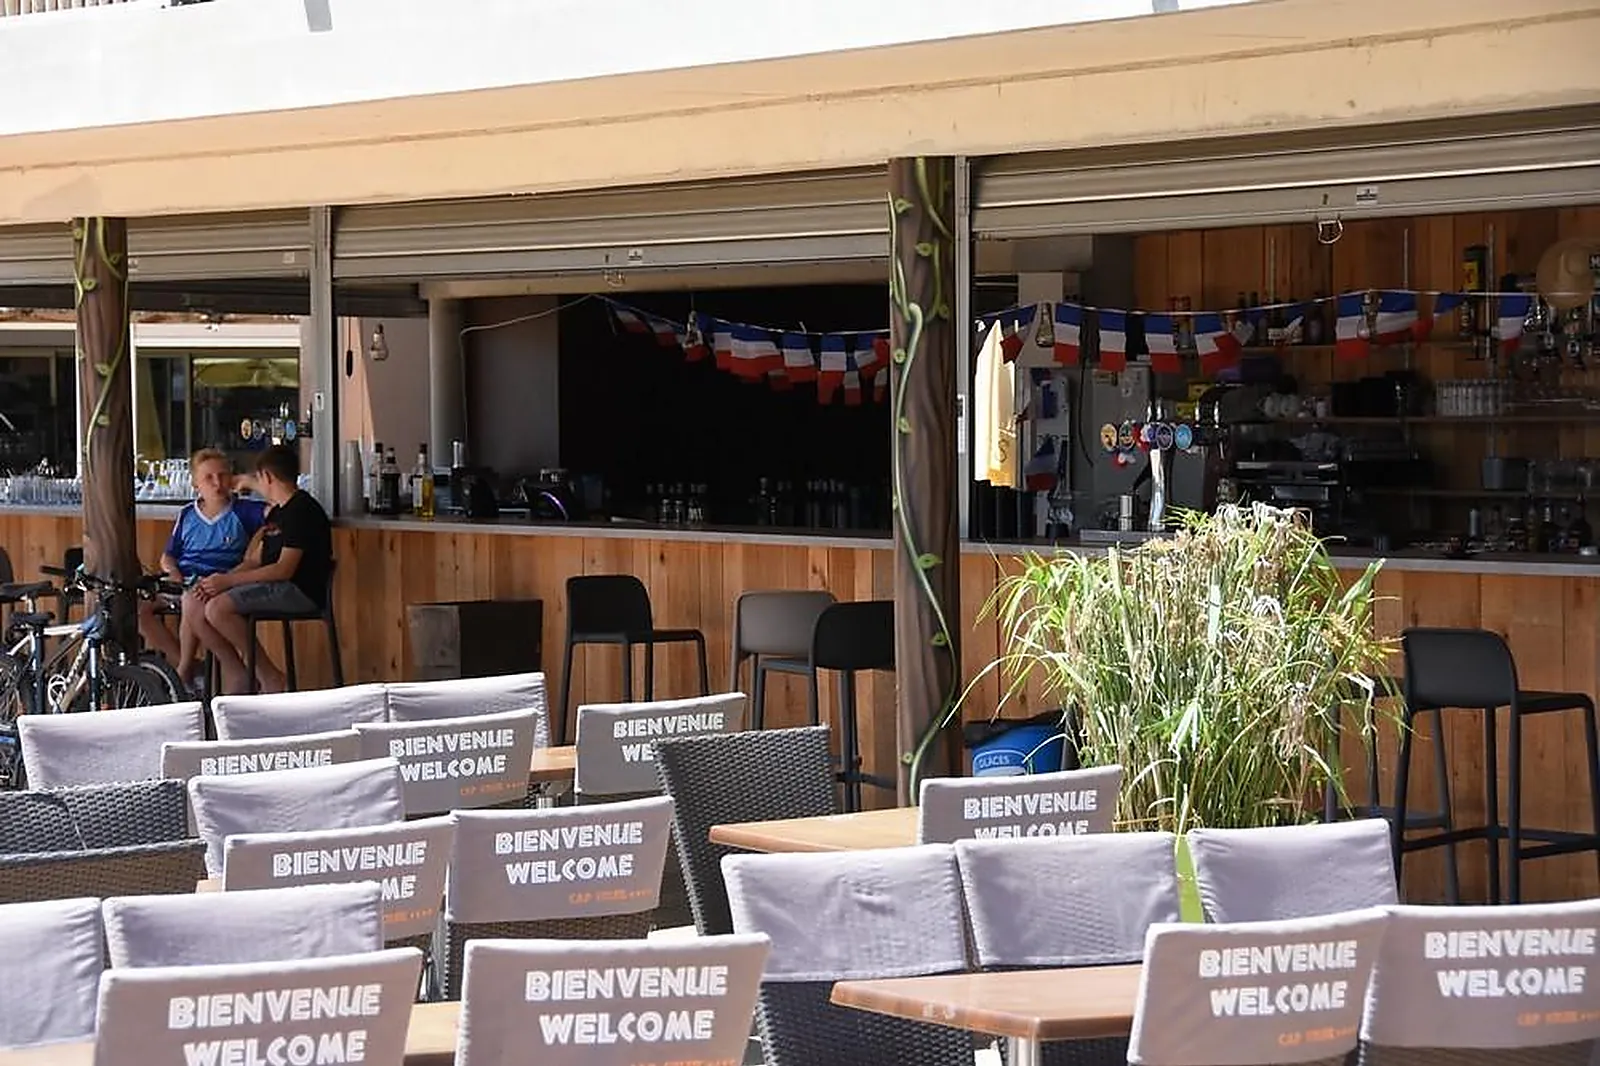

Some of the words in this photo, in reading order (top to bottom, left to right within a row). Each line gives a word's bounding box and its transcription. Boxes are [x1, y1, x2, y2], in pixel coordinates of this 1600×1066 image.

[613, 712, 724, 738] BIENVENUE
[389, 729, 514, 757] BIENVENUE
[201, 748, 332, 776] BIENVENUE
[400, 754, 507, 782] WELCOME
[964, 790, 1097, 819] BIENVENUE
[495, 822, 643, 855] BIENVENUE
[273, 840, 427, 877] BIENVENUE
[505, 854, 634, 884] WELCOME
[1199, 940, 1357, 978] BIENVENUE
[1425, 928, 1597, 959] BIENVENUE
[525, 965, 728, 1001] BIENVENUE
[1437, 966, 1586, 997] WELCOME
[168, 984, 382, 1029] BIENVENUE
[1210, 981, 1348, 1016] WELCOME
[539, 1010, 715, 1045] WELCOME
[183, 1030, 367, 1066] WELCOME
